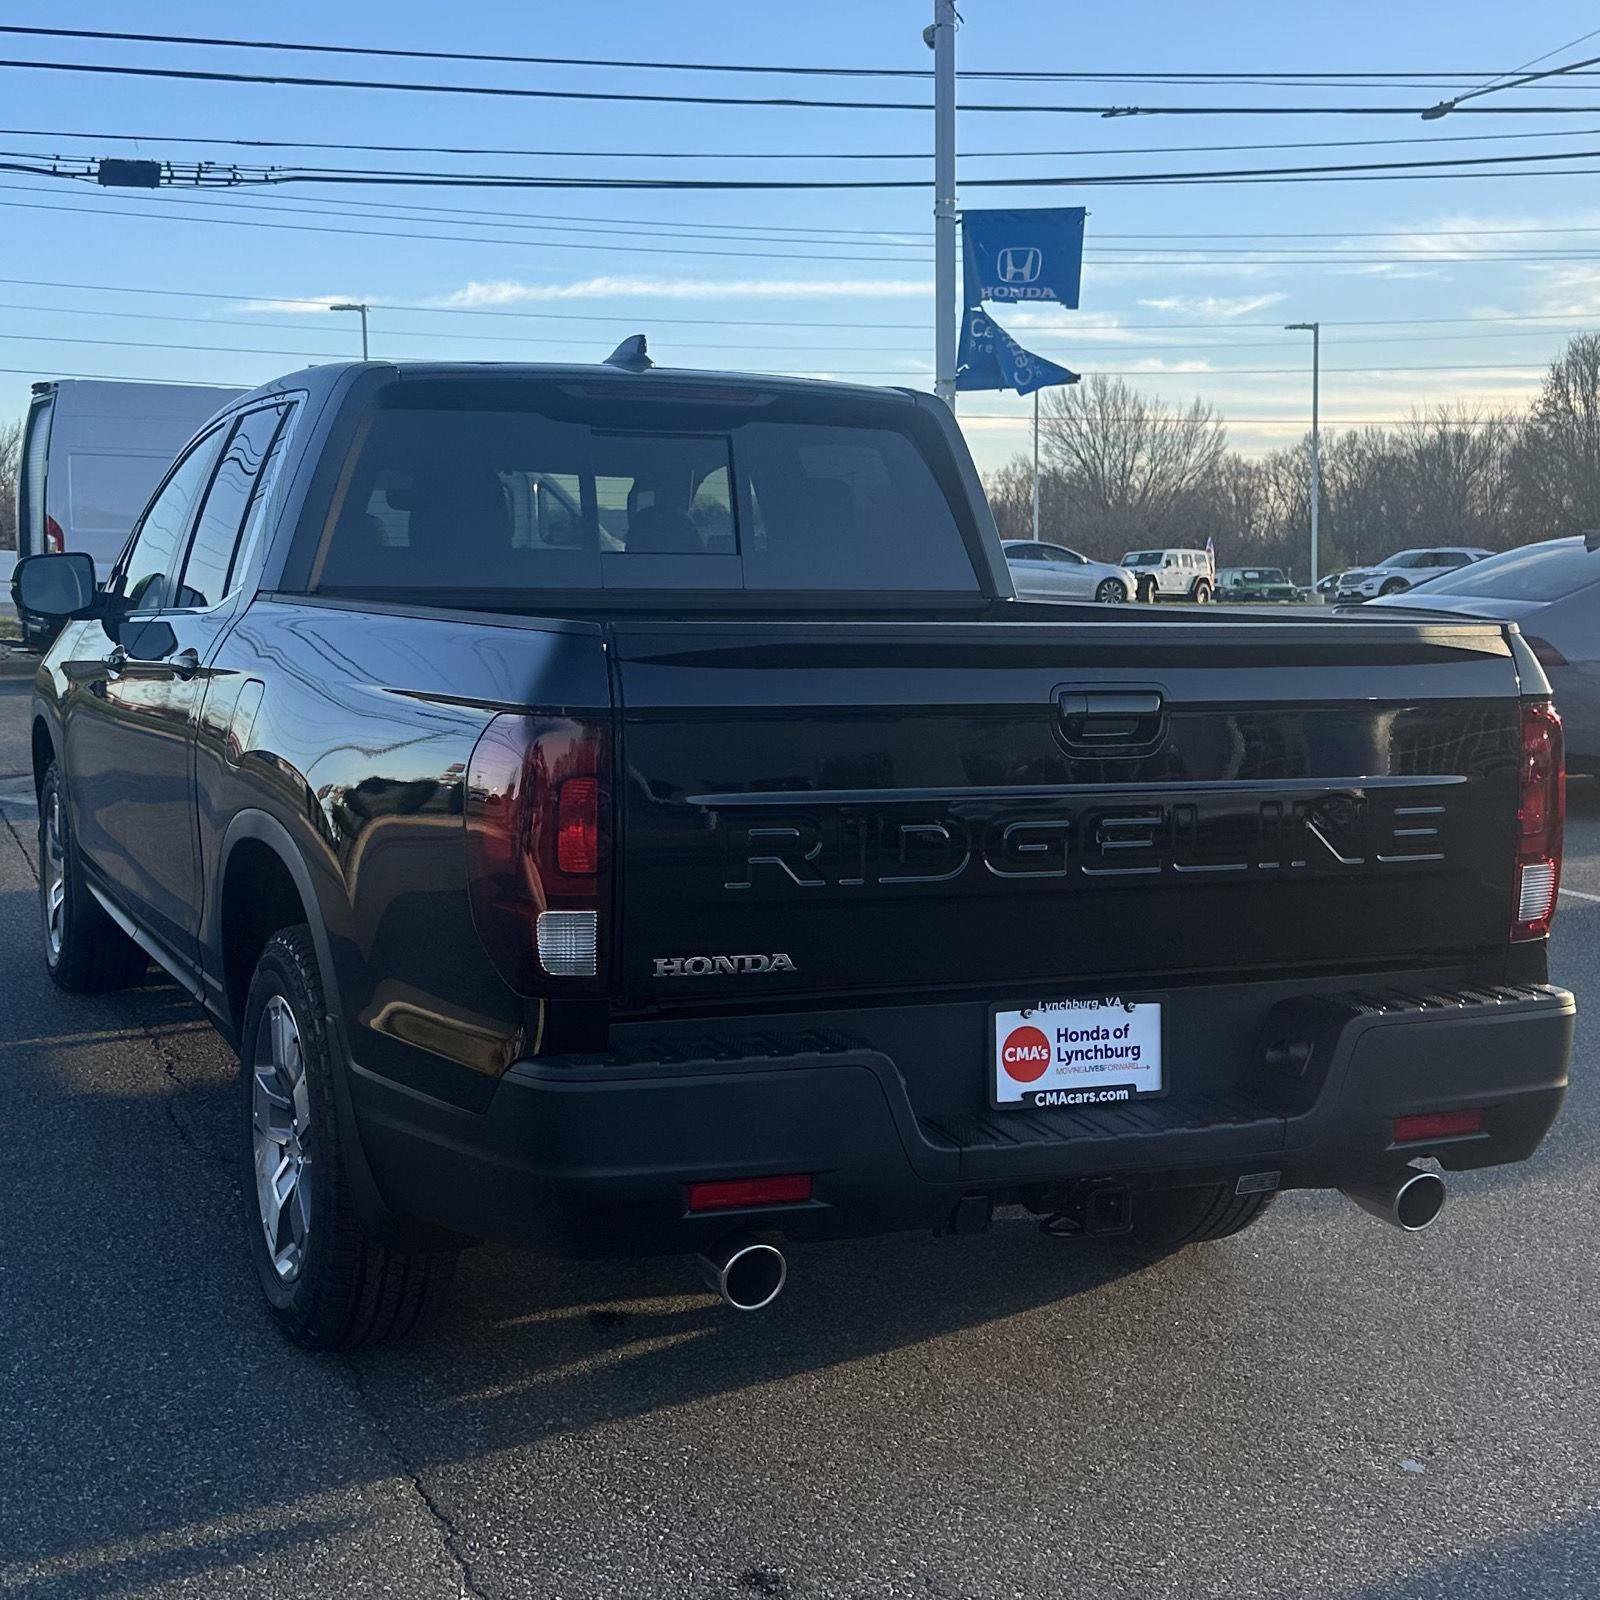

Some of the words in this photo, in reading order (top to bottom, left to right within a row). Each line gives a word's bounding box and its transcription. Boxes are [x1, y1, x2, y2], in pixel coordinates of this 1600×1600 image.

[981, 286, 1057, 298] HONDA
[723, 801, 1447, 889] RIDGELINE
[652, 953, 798, 977] HONDA
[1056, 1025, 1110, 1043] Honda
[1113, 1023, 1130, 1039] of
[1004, 1045, 1049, 1063] CMA's
[1056, 1043, 1141, 1066] Lynchburg
[1034, 1088, 1129, 1107] CMAcars.com
